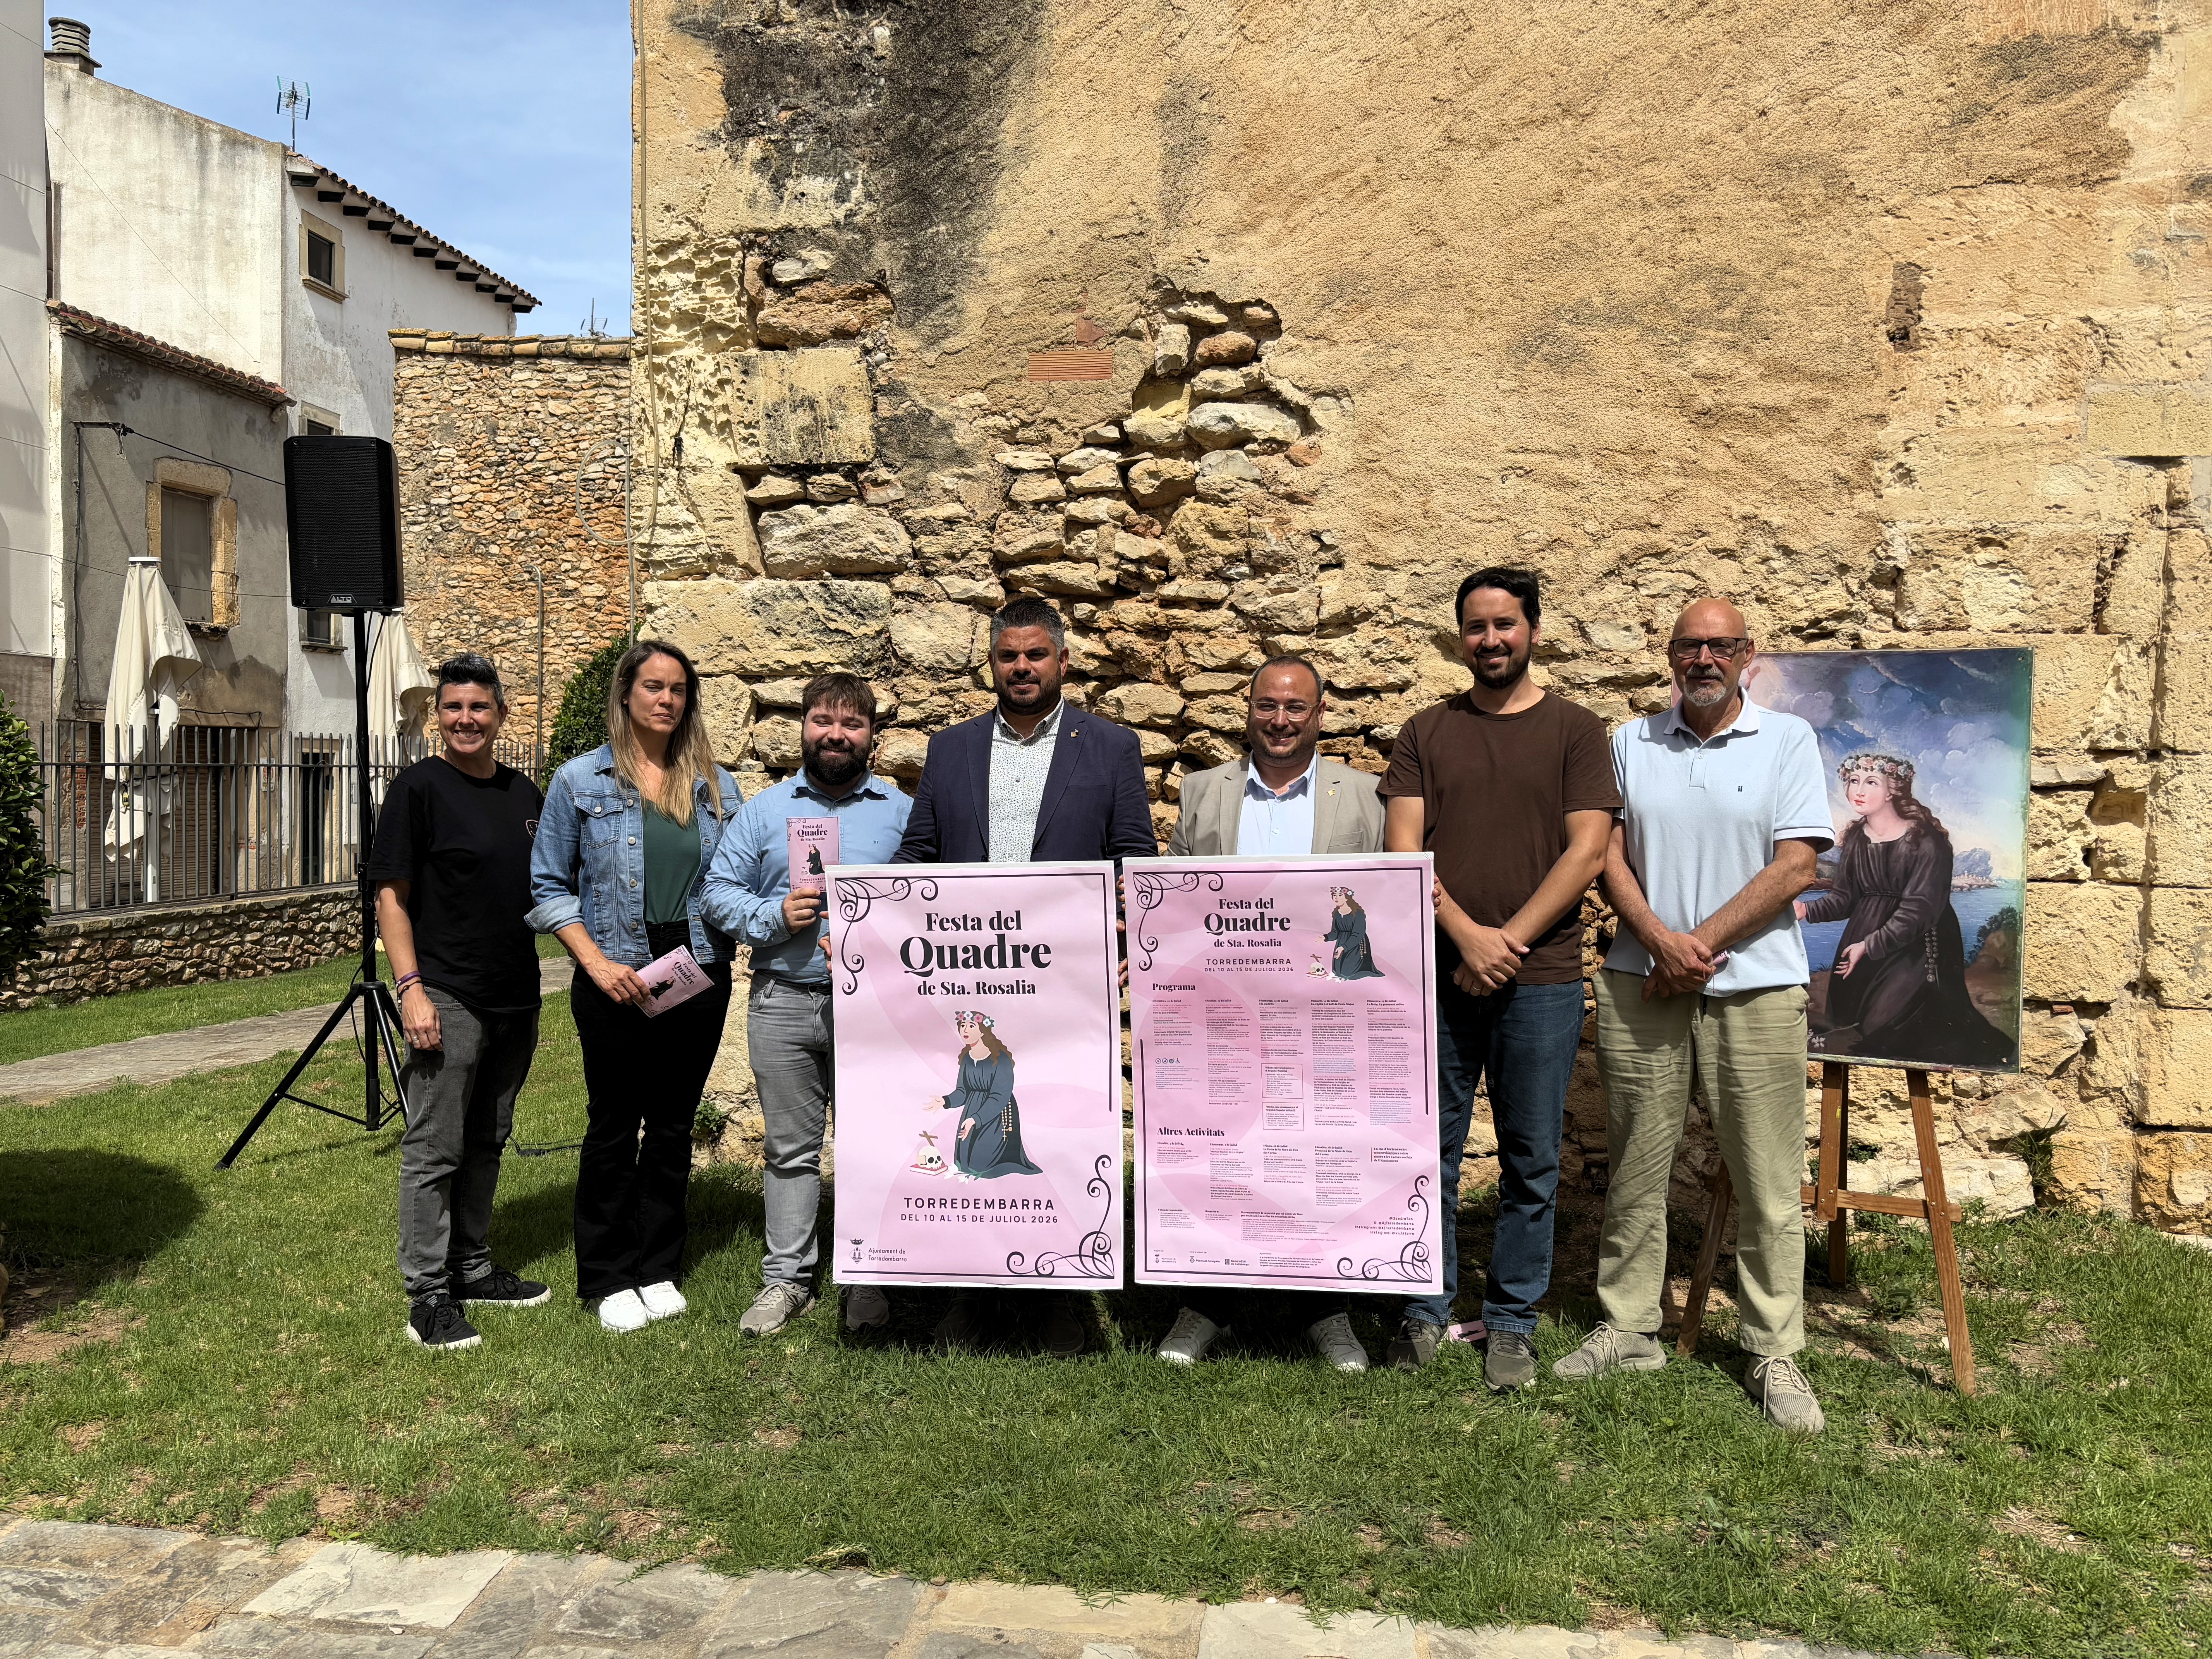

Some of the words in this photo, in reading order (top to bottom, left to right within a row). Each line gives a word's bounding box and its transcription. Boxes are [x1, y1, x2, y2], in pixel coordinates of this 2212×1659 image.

[797, 828, 828, 837] Quadre
[1219, 899, 1251, 909] Festa
[1255, 898, 1274, 909] del
[925, 912, 982, 932] Festa
[989, 910, 1022, 931] del
[1204, 912, 1291, 936] Quadre
[1214, 939, 1224, 947] de
[1247, 939, 1281, 947] Rosalia
[900, 933, 1051, 977] Quadre
[673, 962, 695, 985] Quadre
[683, 963, 692, 973] Festa
[917, 981, 936, 996] de
[940, 981, 971, 995] Sta.
[975, 979, 1036, 995] Rosalia
[1152, 983, 1195, 992] Programa
[1157, 1127, 1183, 1135] Altres
[1185, 1128, 1224, 1136] Activitats
[904, 1197, 1055, 1211] TORREDEMBARRA
[901, 1213, 920, 1222] DEL
[989, 1215, 1027, 1223] JULIOL
[1031, 1215, 1058, 1224] 2026
